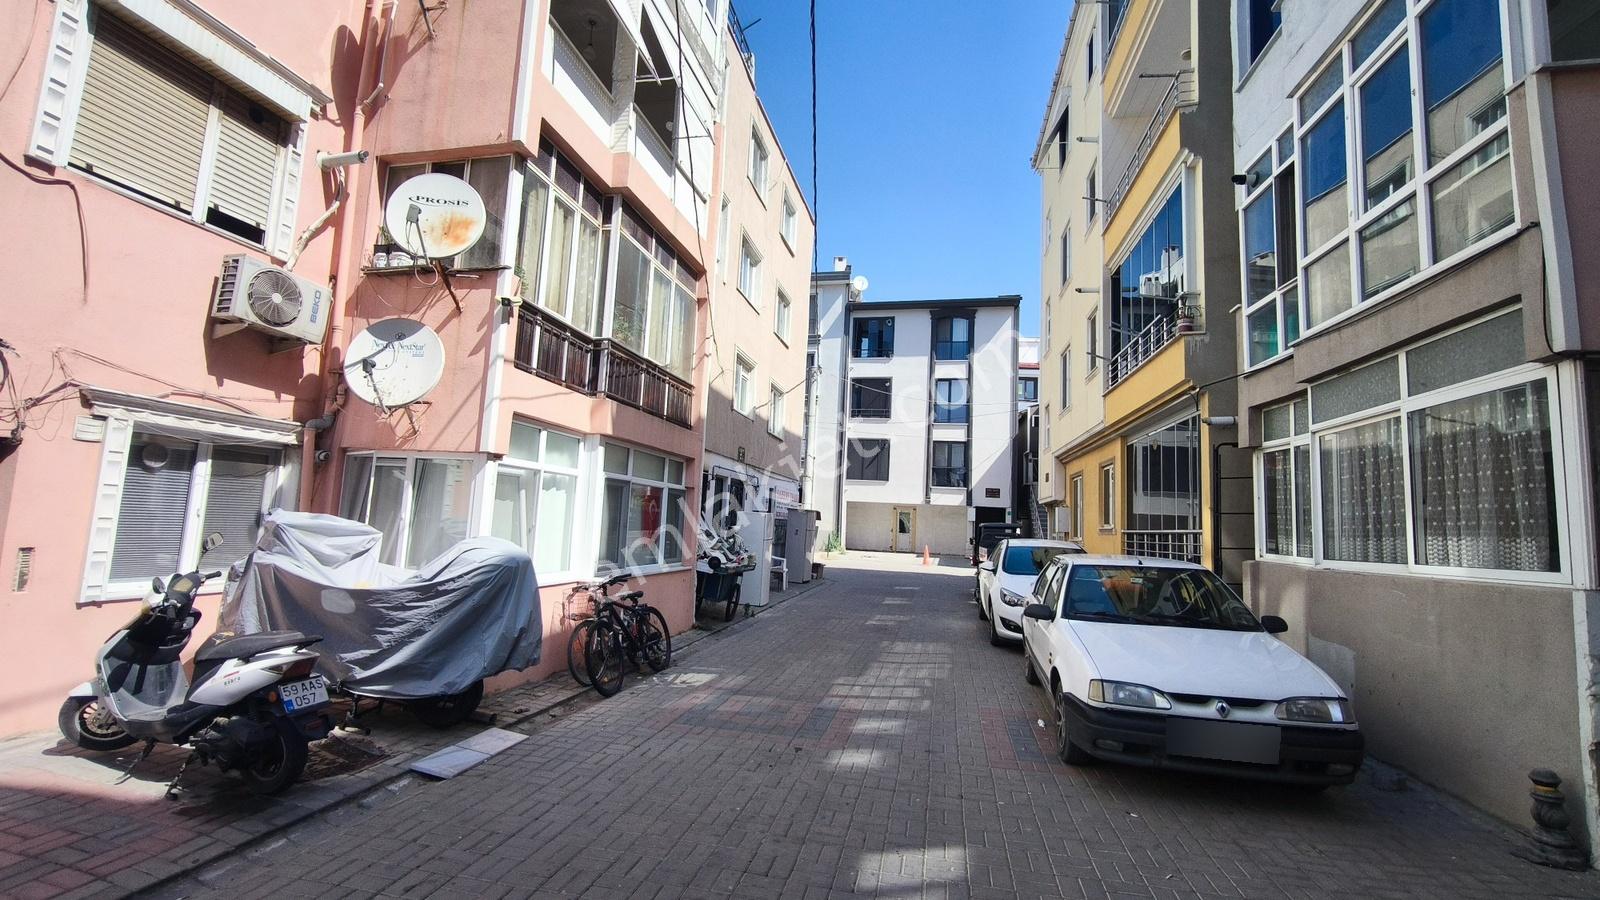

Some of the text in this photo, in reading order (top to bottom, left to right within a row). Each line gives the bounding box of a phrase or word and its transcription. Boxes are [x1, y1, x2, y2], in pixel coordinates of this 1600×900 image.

[310, 290, 321, 323] BEKO
[282, 679, 323, 697] 59 AAS
[295, 692, 316, 706] 057
